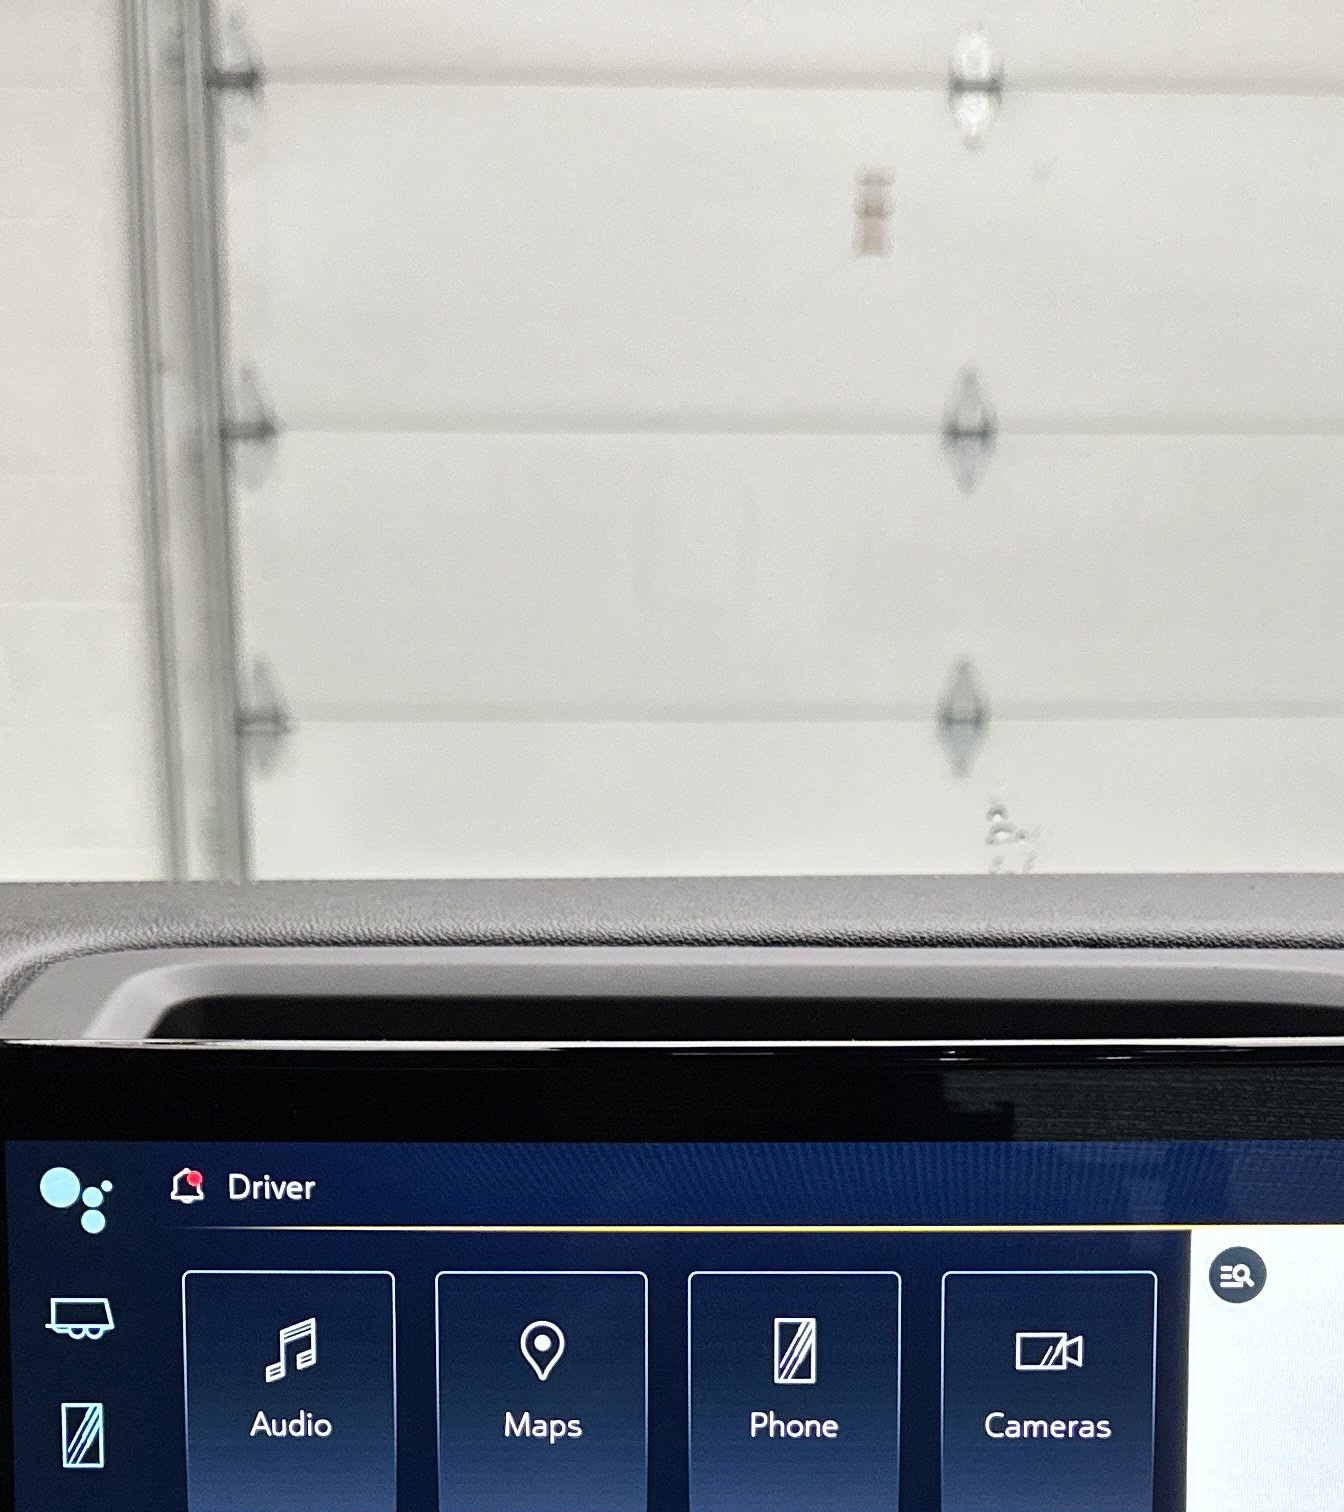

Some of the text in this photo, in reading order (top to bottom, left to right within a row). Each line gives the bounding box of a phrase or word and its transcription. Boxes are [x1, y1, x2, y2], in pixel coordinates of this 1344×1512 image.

[228, 1173, 316, 1201] Driver
[249, 1409, 333, 1438] Audio
[504, 1411, 584, 1445] Maps
[750, 1410, 840, 1438] Phone
[984, 1411, 1113, 1439] Cameras
